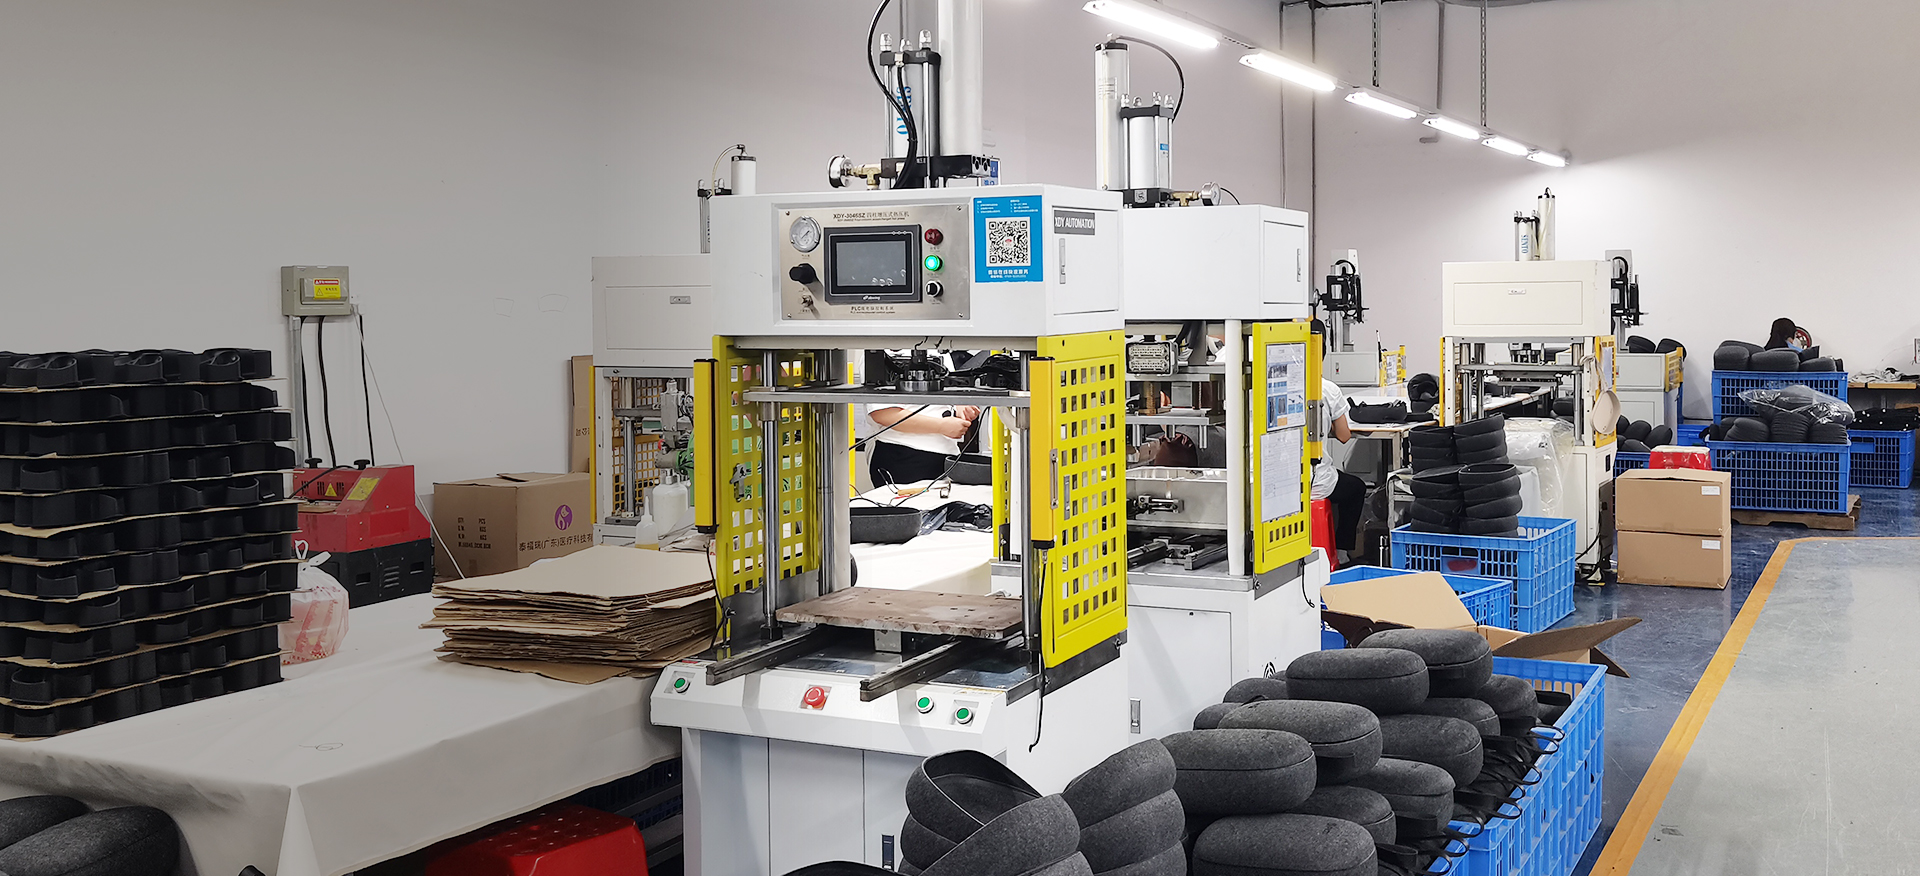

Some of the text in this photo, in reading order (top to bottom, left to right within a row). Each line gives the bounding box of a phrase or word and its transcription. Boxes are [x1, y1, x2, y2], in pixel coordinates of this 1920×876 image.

[896, 86, 912, 135] SEO
[1054, 216, 1095, 229] XDY AUTOMATION
